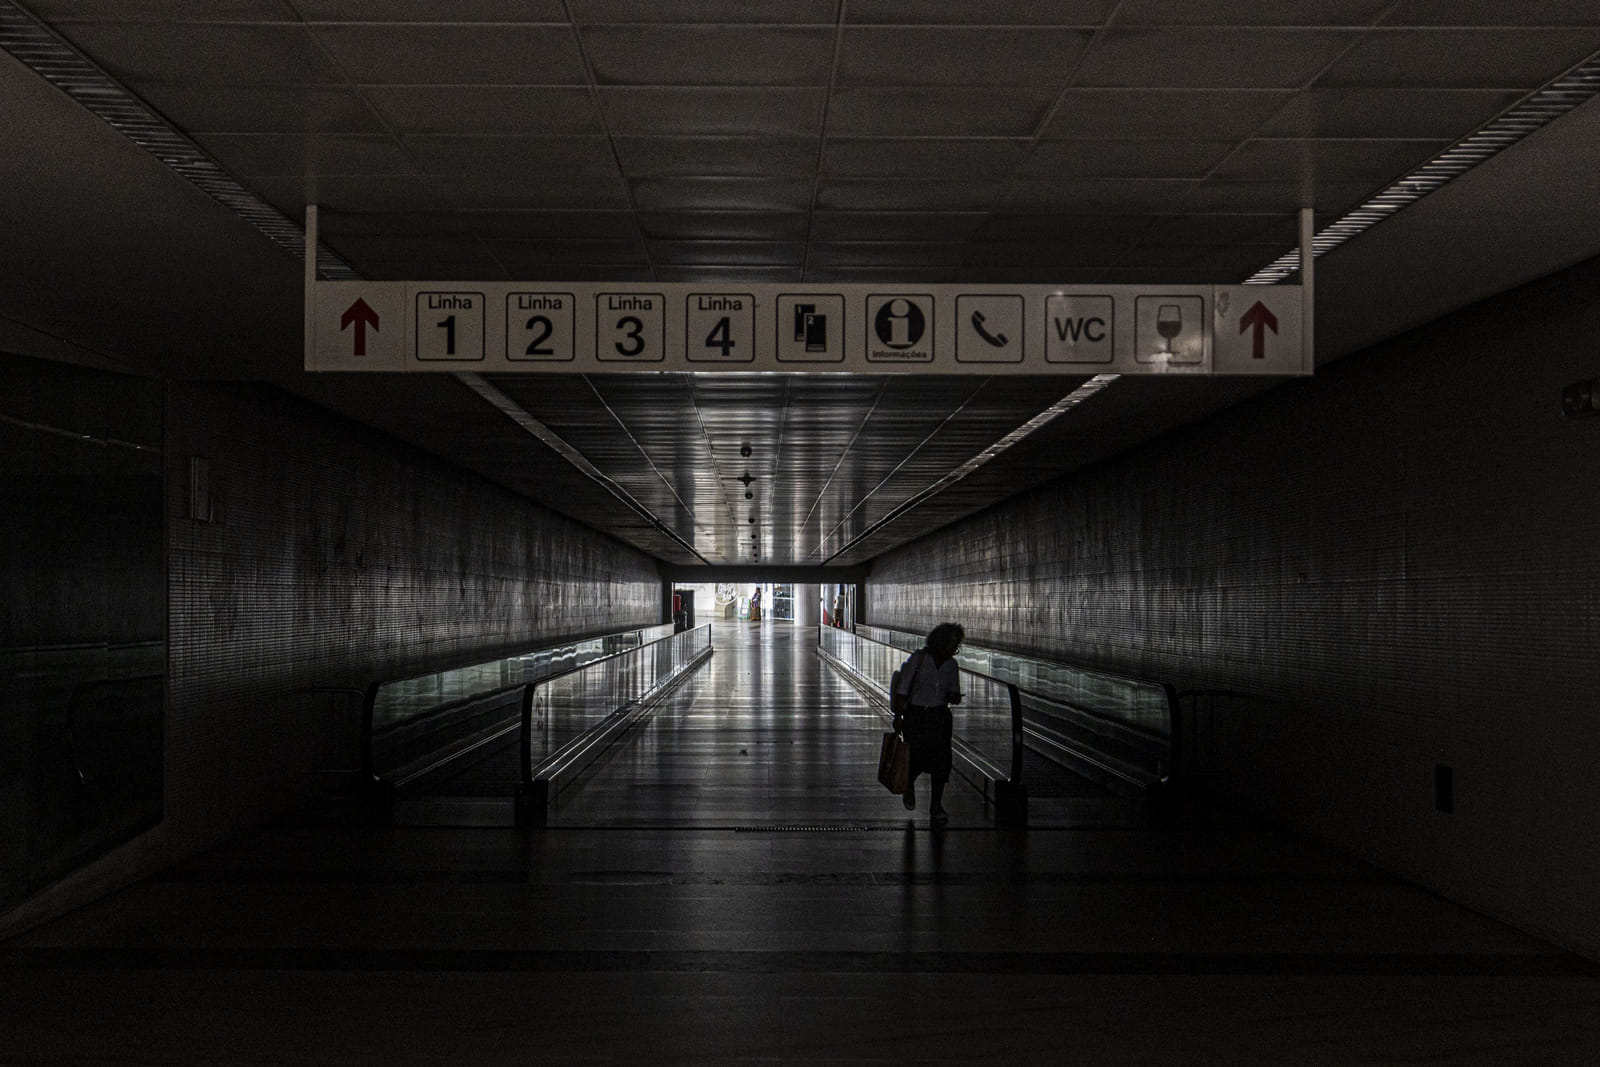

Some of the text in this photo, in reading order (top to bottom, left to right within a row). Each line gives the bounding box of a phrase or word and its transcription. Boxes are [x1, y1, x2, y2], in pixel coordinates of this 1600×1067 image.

[428, 295, 472, 310] Linha
[518, 295, 562, 311] Linha
[608, 296, 653, 311] Linha
[698, 296, 742, 312] Linha
[437, 314, 455, 355] 1
[525, 315, 554, 355] 2
[615, 316, 645, 356] 3
[705, 317, 735, 356] 4
[1055, 317, 1106, 341] WC
